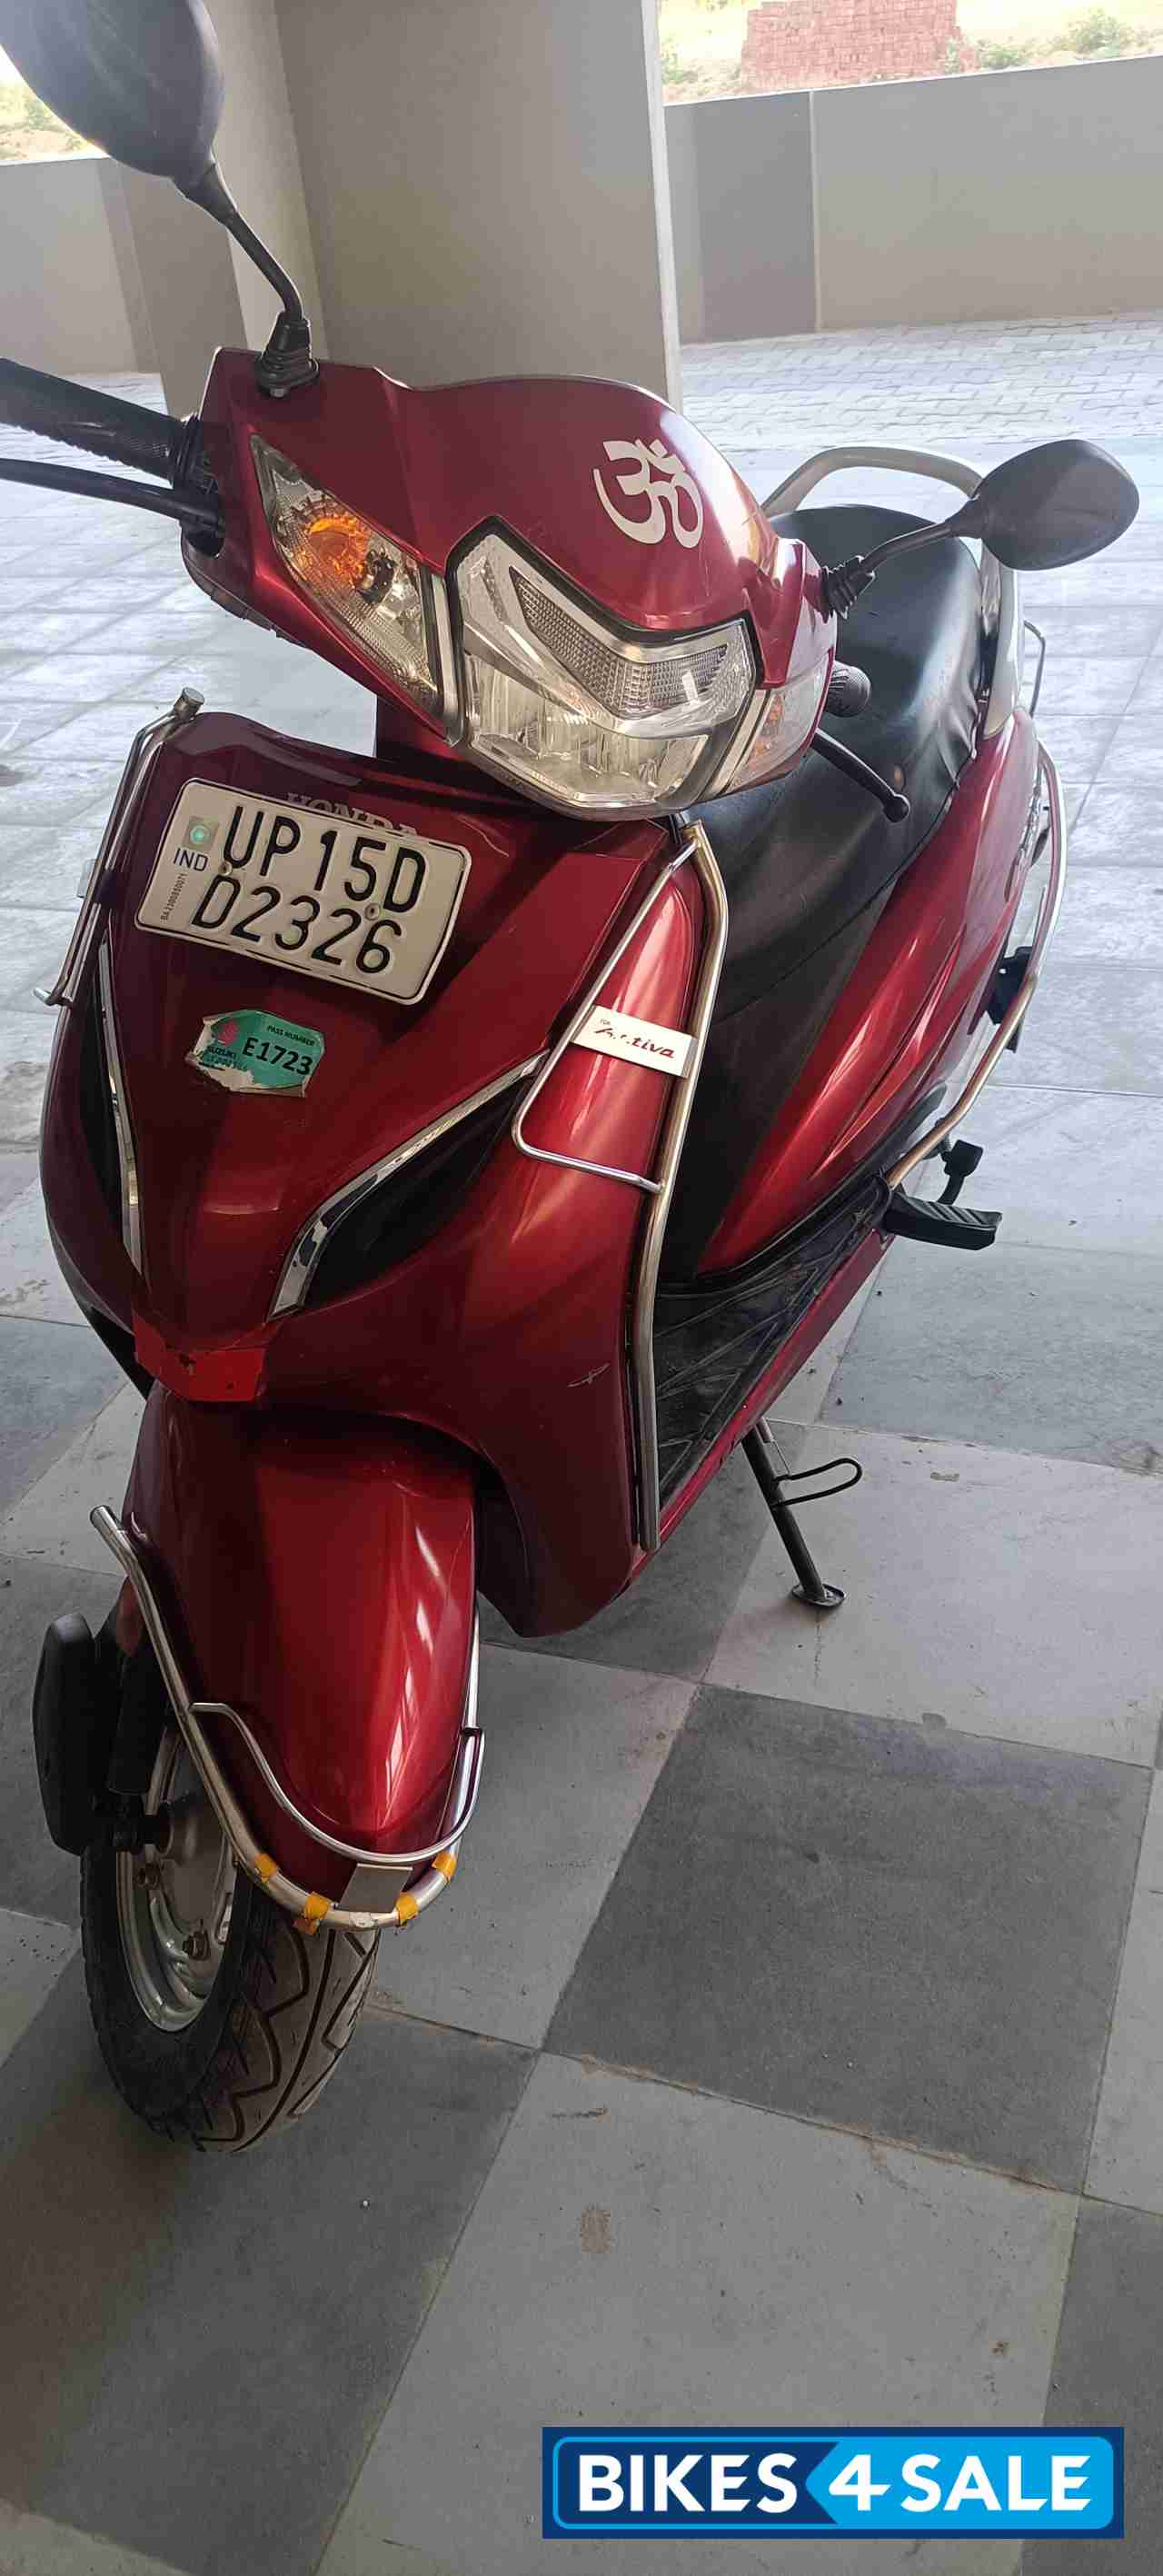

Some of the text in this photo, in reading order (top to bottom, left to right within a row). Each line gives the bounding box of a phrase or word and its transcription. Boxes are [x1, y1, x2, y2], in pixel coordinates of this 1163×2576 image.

[174, 848, 209, 871] IND
[192, 875, 403, 974] D2326
[242, 1037, 313, 1076] E1723
